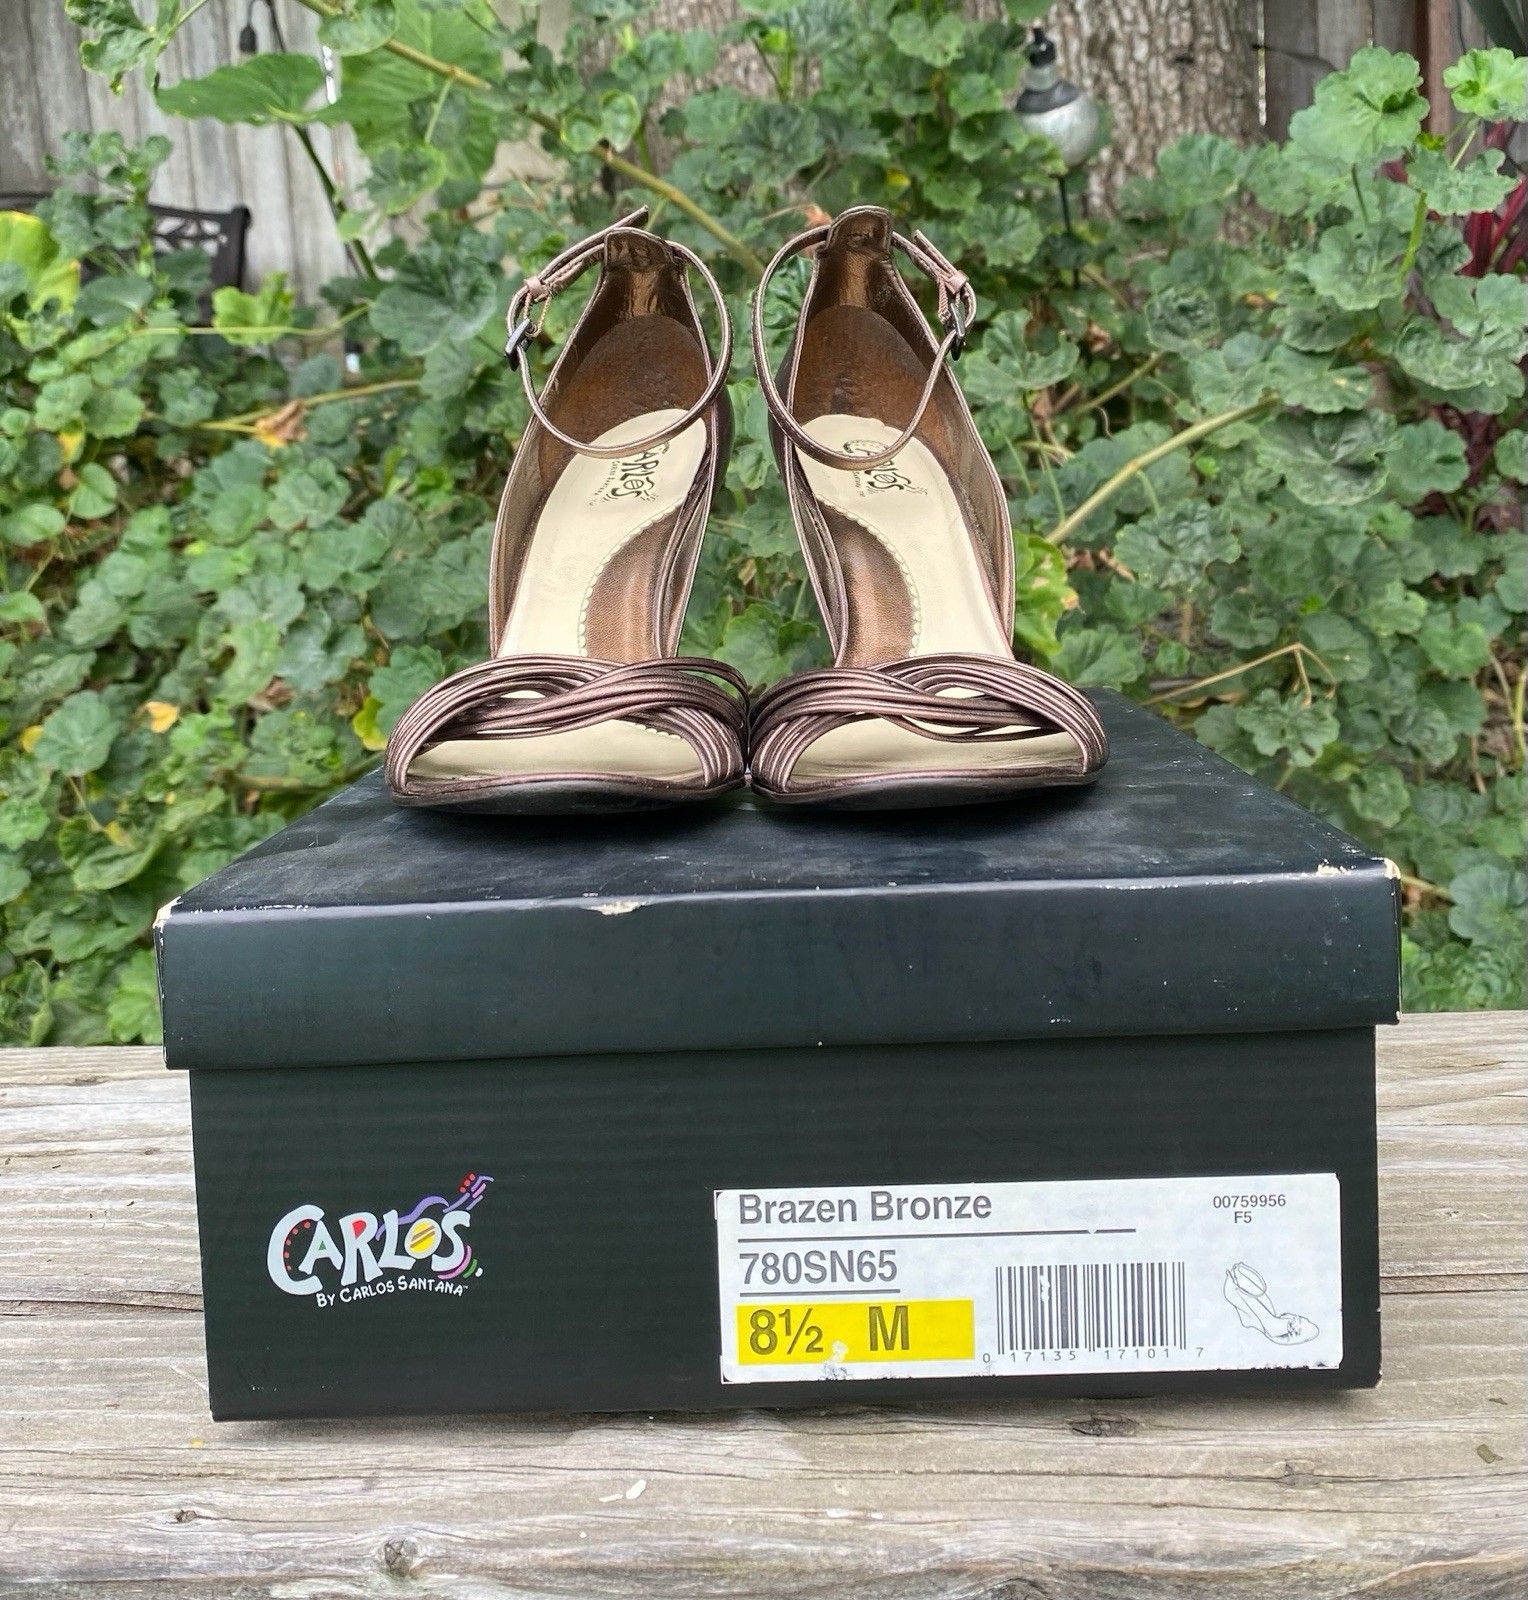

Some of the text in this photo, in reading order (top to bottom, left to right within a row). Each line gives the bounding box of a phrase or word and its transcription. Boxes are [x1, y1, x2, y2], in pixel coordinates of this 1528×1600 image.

[611, 441, 670, 497] ARLOS
[739, 1190, 992, 1225] Brazen Bronze
[1213, 1194, 1286, 1208] 00759956
[1234, 1211, 1252, 1223] F5
[267, 1204, 470, 1295] CARLOS
[739, 1250, 898, 1285] 780SN65
[316, 1292, 335, 1307] BY
[339, 1281, 395, 1303] CARLOS
[869, 1305, 910, 1352] M
[1010, 1350, 1077, 1362] 17135
[1104, 1348, 1170, 1360] 17101
[1196, 1347, 1204, 1358] 7
